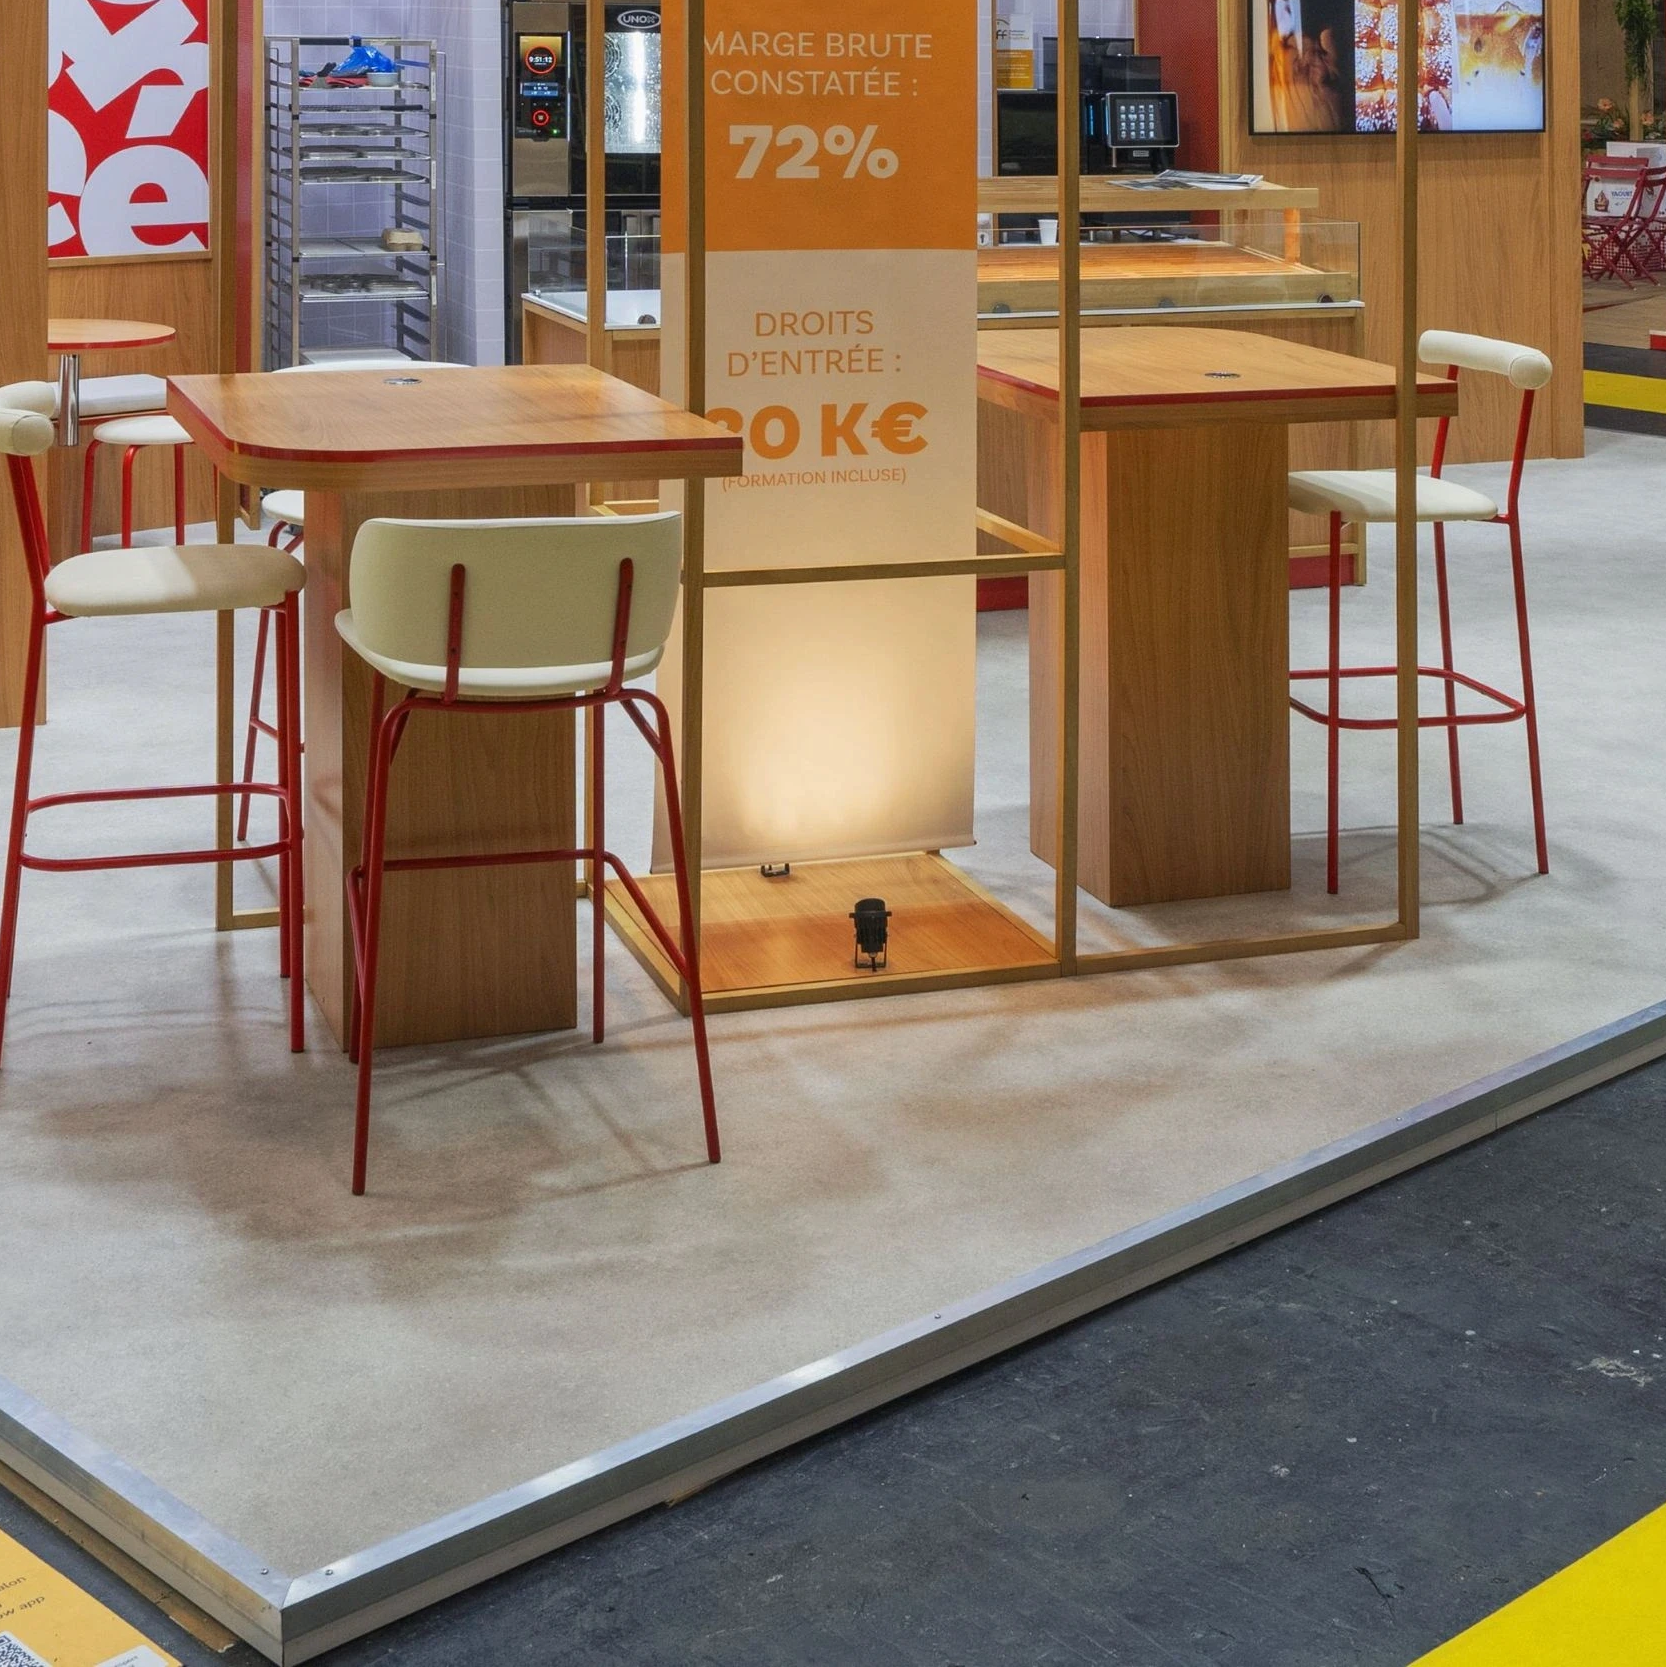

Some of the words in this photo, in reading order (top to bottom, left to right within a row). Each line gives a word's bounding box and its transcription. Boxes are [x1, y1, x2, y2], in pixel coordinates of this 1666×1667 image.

[704, 31, 815, 57] MARGE
[826, 33, 933, 60] BRUTE
[709, 66, 901, 97] CONSTATÉE
[729, 124, 899, 179] 72%
[755, 310, 875, 337] DROITS
[820, 401, 929, 458] K€
[831, 467, 907, 485] INCLUSE)
[18, 1595, 46, 1611] app
